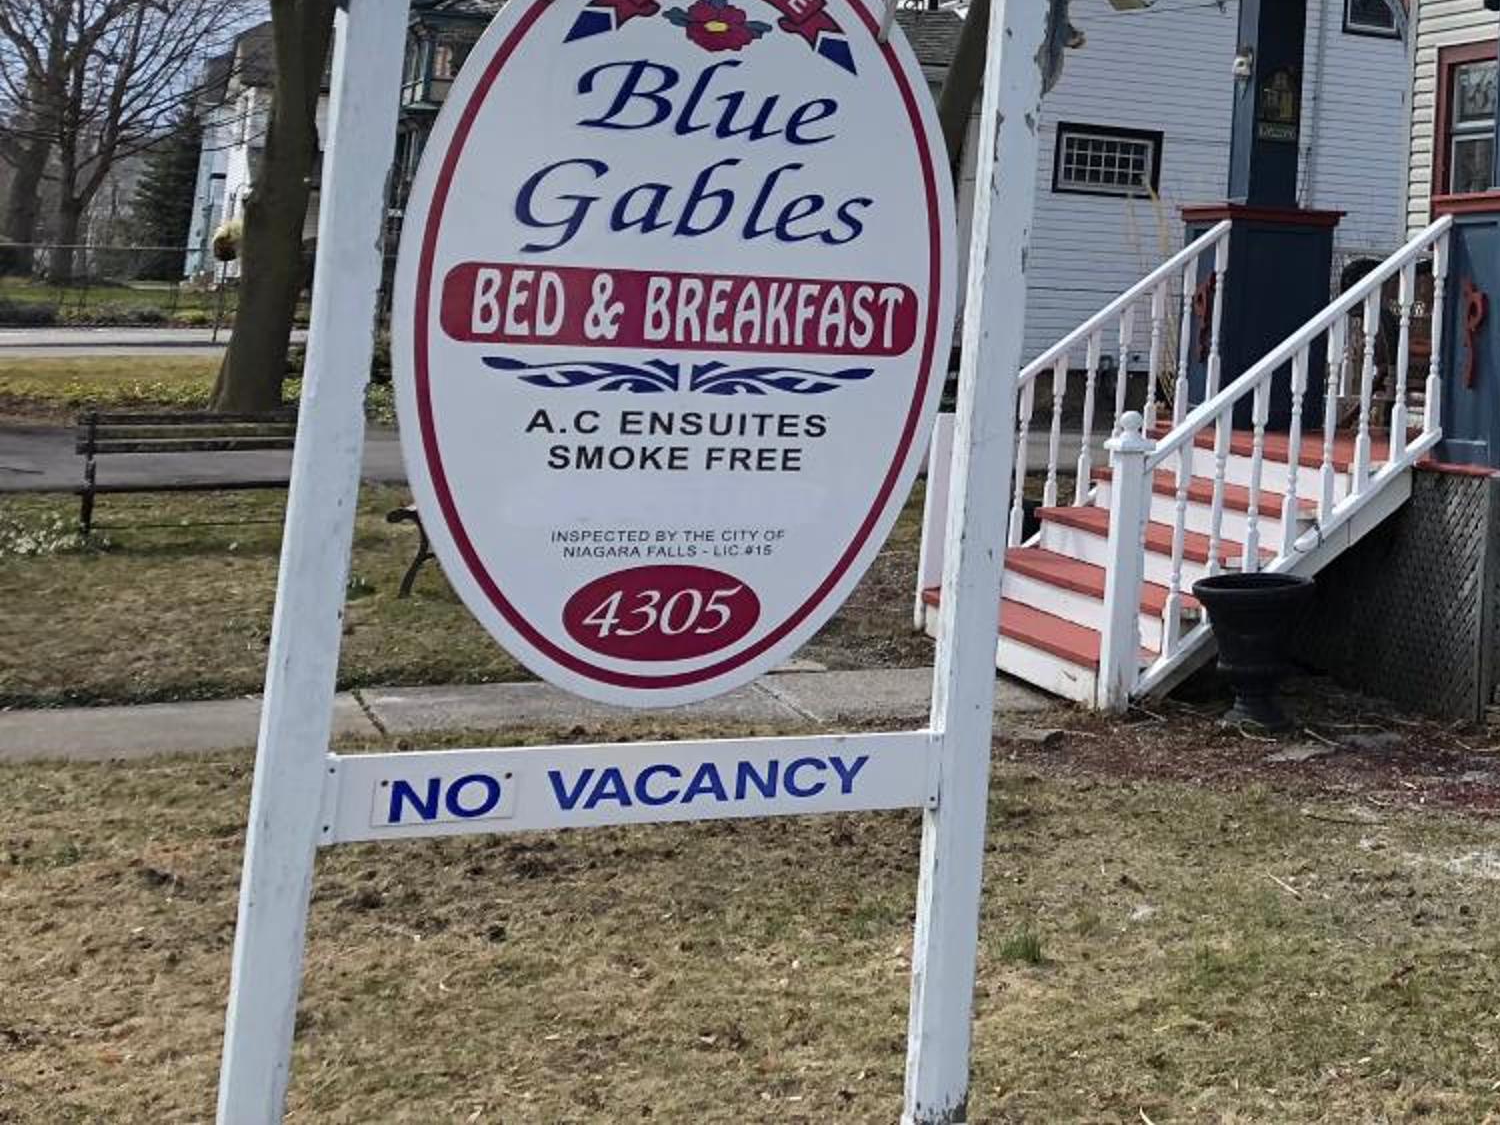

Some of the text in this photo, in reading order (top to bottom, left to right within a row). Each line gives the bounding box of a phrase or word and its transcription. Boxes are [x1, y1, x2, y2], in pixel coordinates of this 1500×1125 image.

[576, 59, 838, 145] Blue
[514, 158, 874, 253] Gables
[470, 268, 905, 349] BED & BREAKFAST
[525, 409, 828, 438] A.C ENSUITES
[547, 445, 802, 472] SMOKE FREE
[551, 529, 785, 543] INSPECTED BY THE CITY OF
[563, 546, 641, 559] NIAGARA
[647, 546, 697, 558] FALLS
[582, 585, 744, 638] 4305
[387, 755, 870, 824] NO VACANCY
